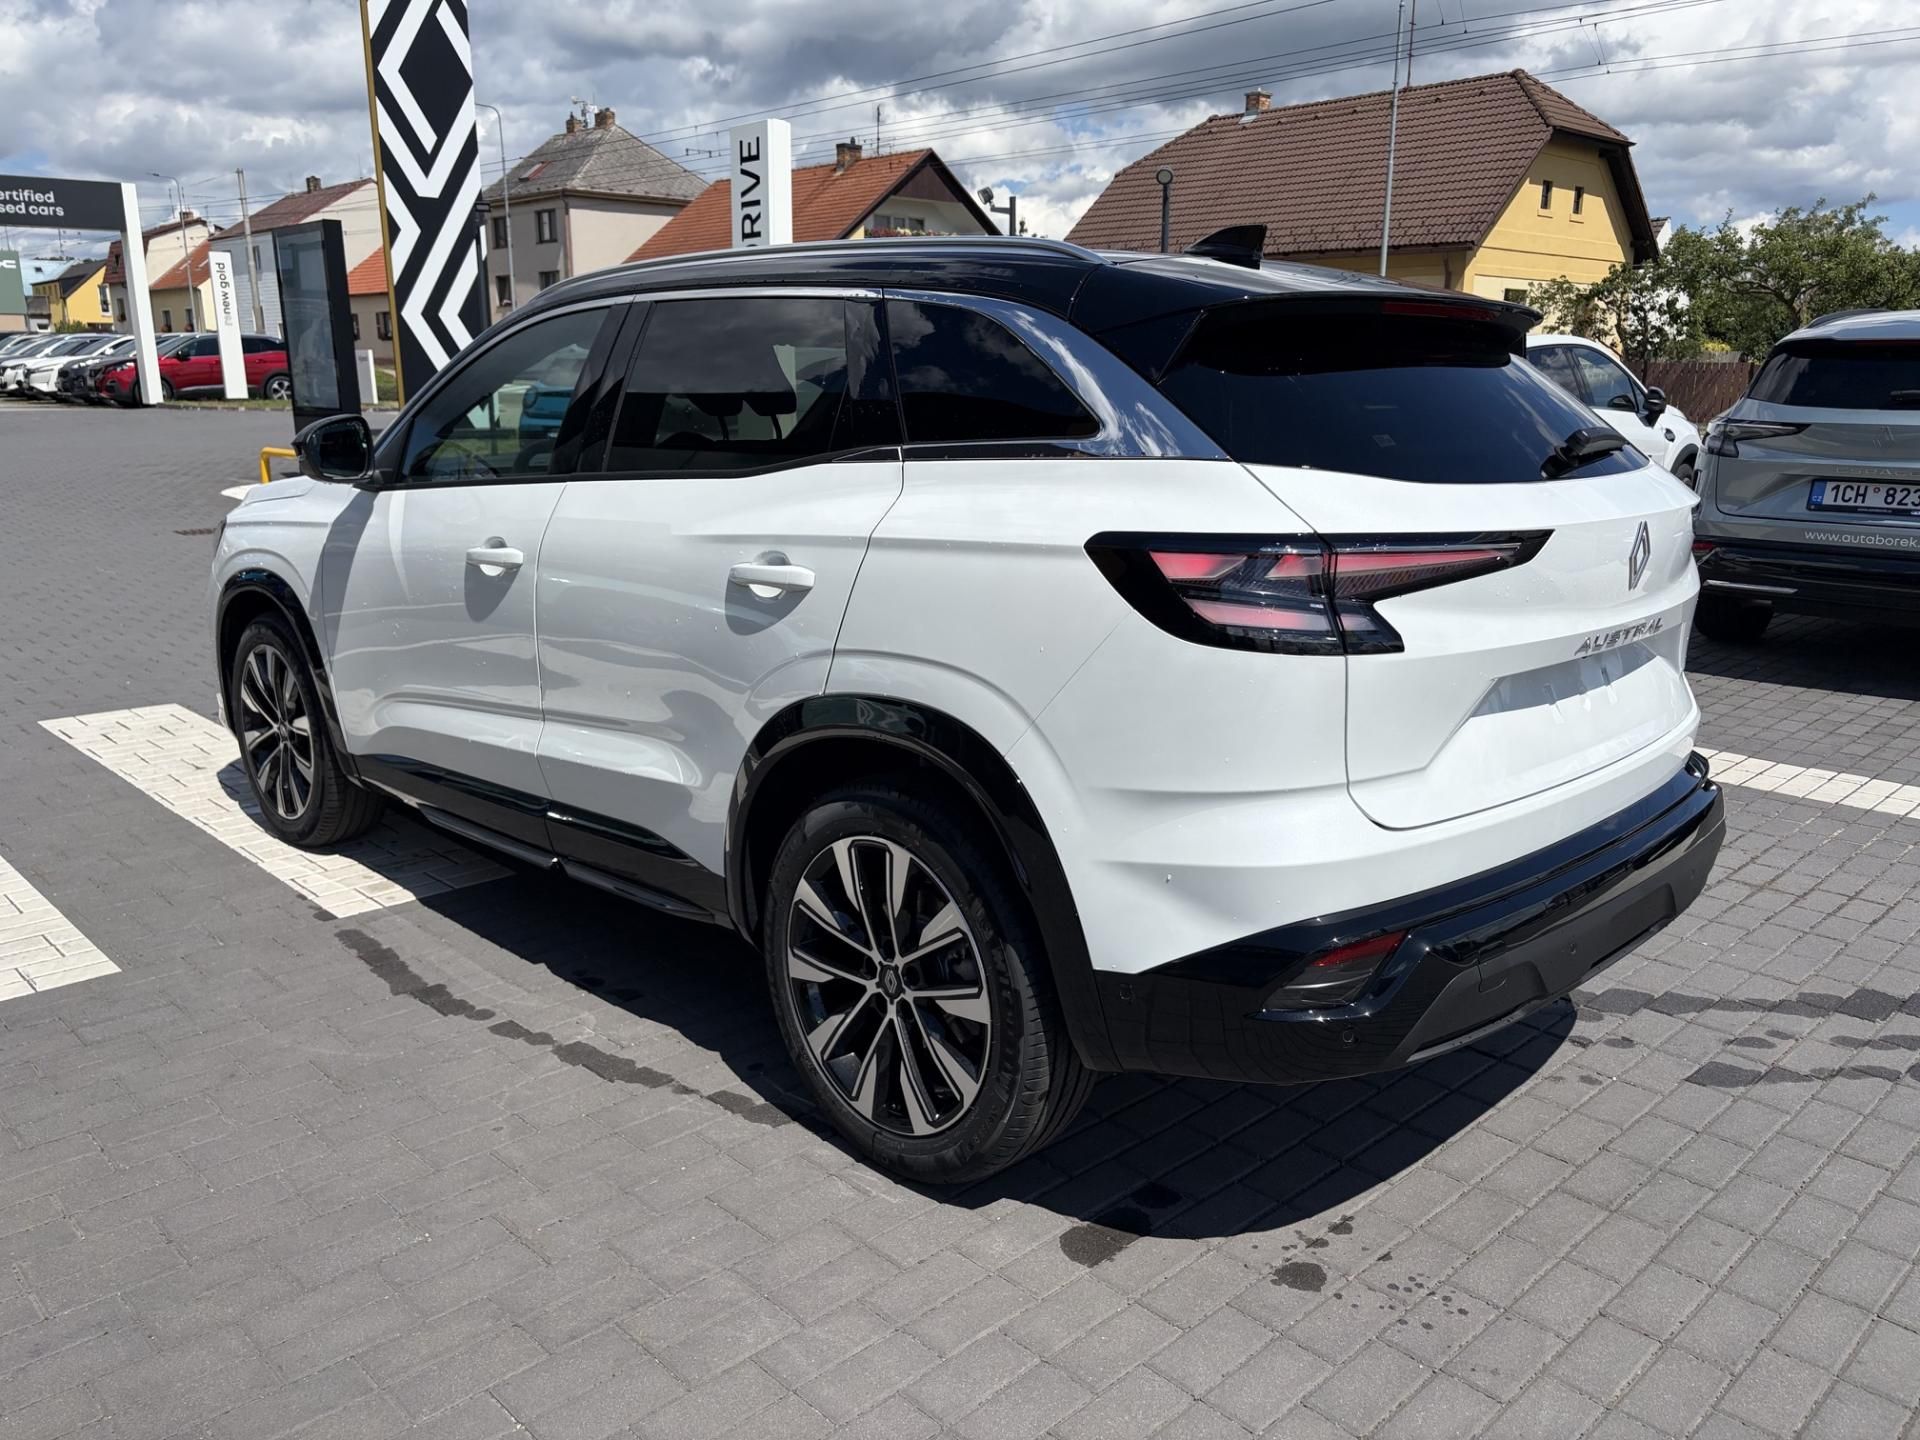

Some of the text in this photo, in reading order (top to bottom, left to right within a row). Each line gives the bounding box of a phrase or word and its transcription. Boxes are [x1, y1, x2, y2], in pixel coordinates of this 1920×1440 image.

[739, 136, 762, 247] RIVE
[0, 202, 65, 216] sed cars
[215, 262, 230, 289] gold
[1831, 484, 1920, 507] 1CH 823
[1573, 617, 1664, 656] AUSTRAL
